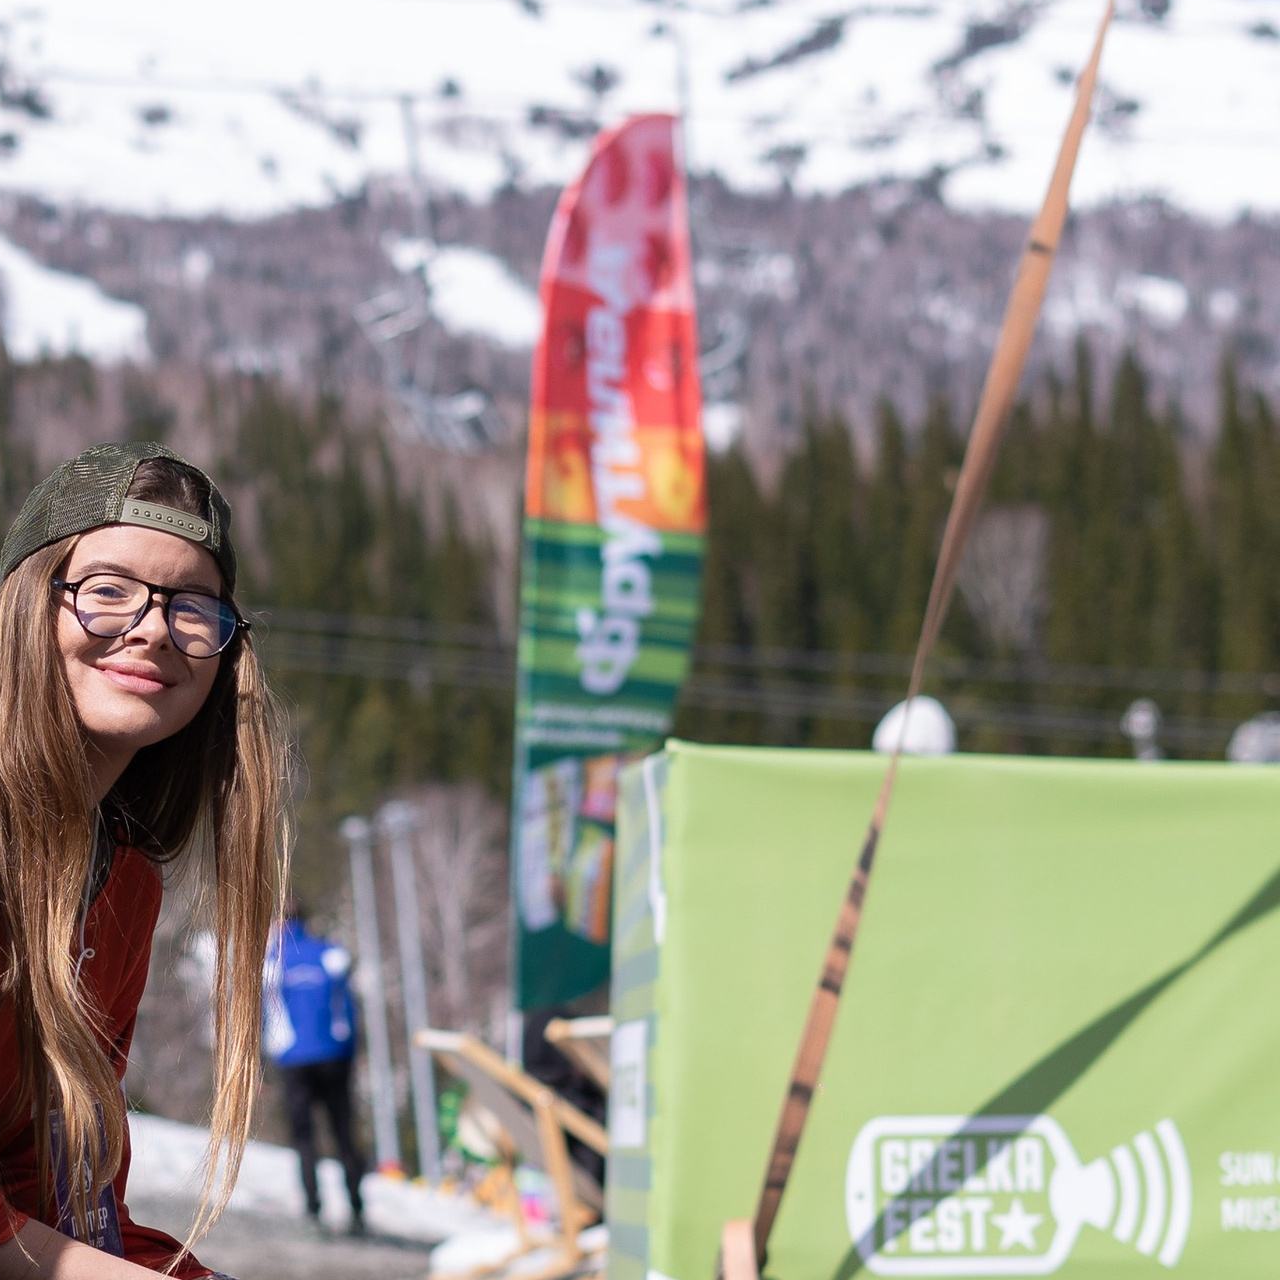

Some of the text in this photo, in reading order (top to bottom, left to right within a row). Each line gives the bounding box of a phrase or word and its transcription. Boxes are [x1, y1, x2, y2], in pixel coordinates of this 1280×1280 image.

[881, 1138, 1044, 1194] GRELKA
[1219, 1150, 1273, 1187] SUN
[884, 1197, 993, 1253] FEST
